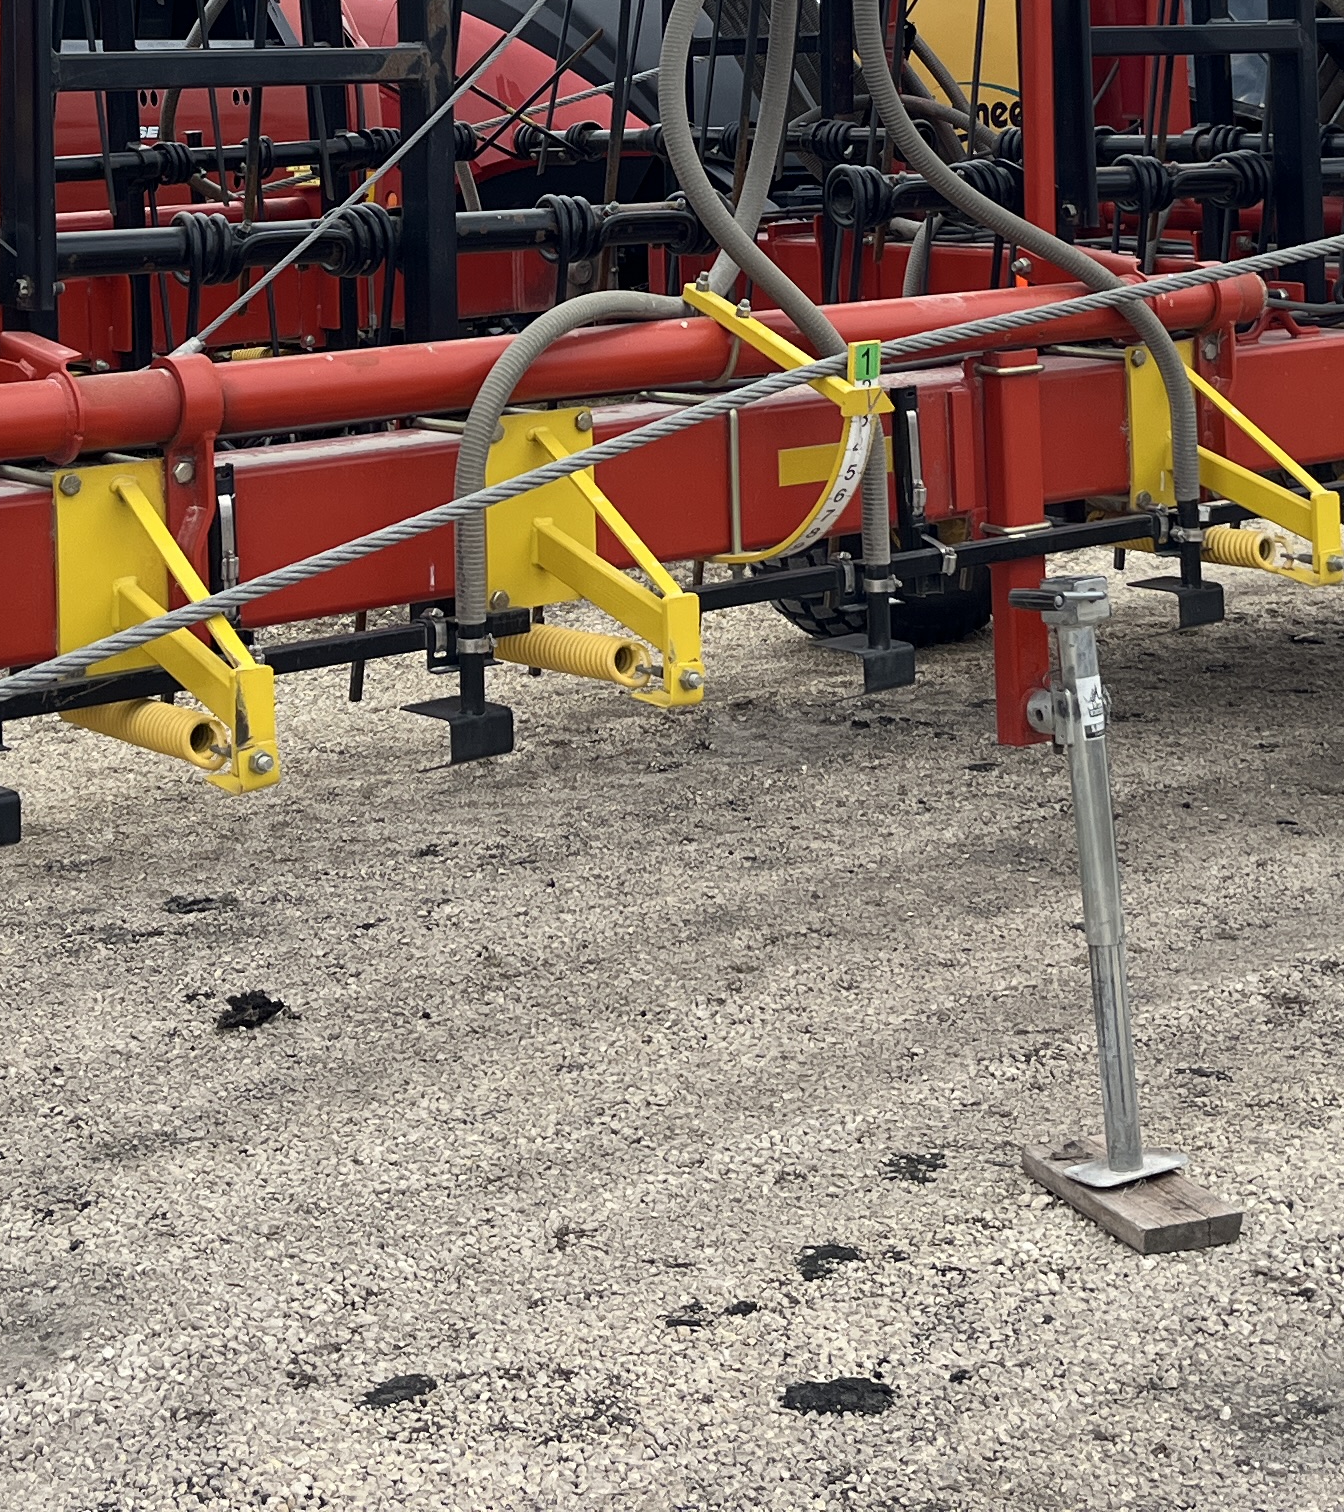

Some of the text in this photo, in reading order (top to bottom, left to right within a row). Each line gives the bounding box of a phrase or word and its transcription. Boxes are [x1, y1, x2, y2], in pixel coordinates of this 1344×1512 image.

[861, 347, 870, 376] 1
[844, 464, 857, 480] 5
[833, 488, 847, 503] 6
[820, 509, 835, 522] 7
[806, 528, 820, 538] 8
